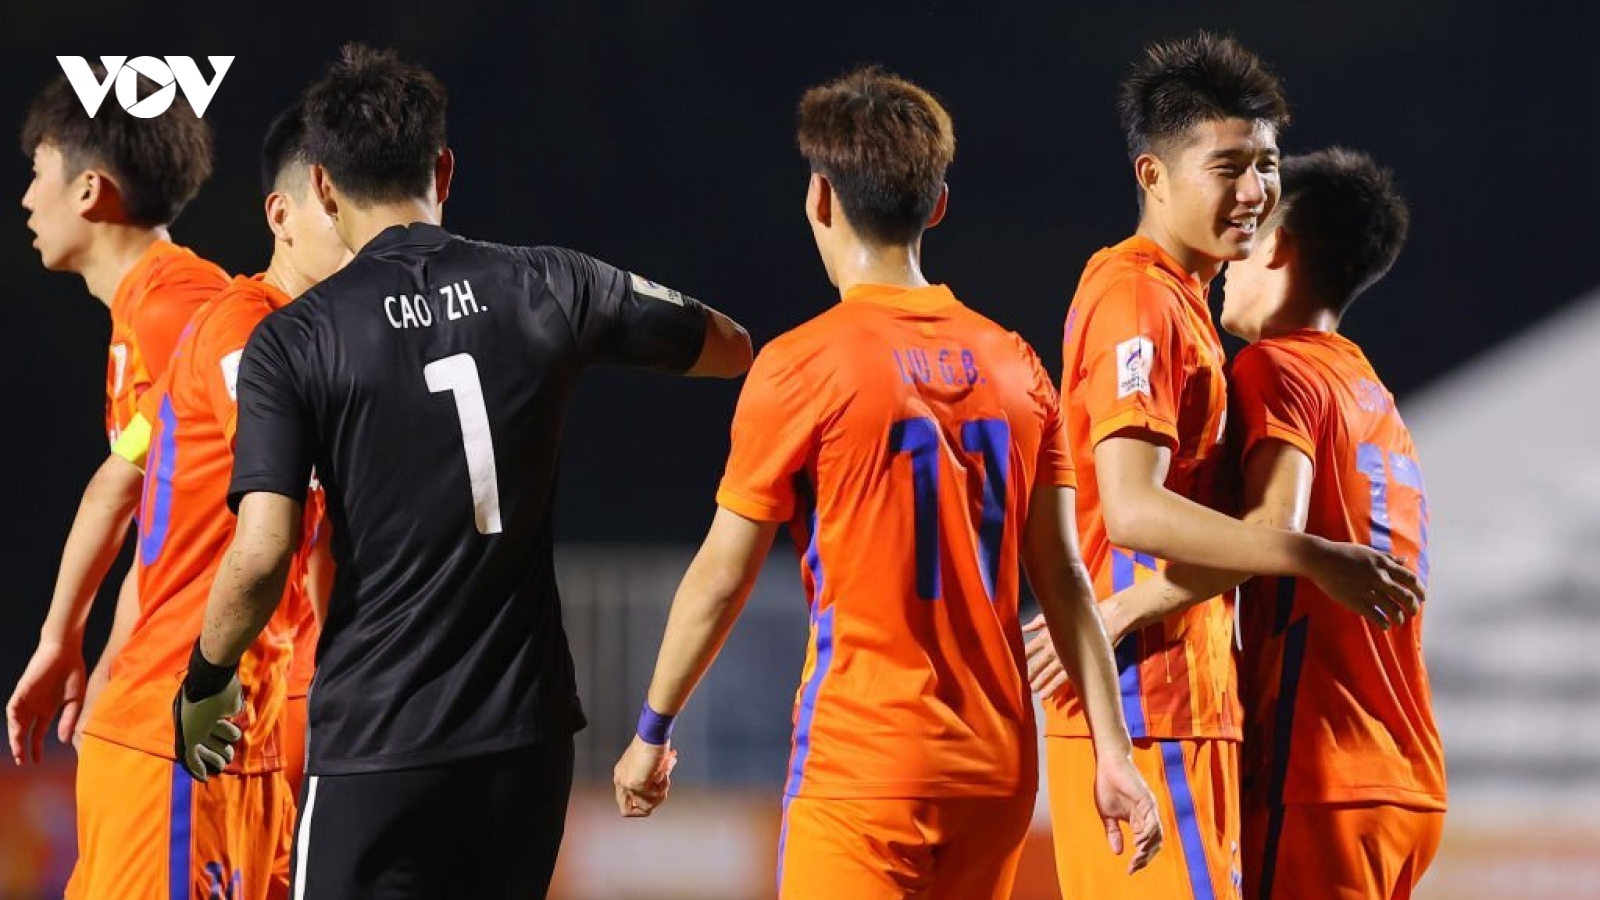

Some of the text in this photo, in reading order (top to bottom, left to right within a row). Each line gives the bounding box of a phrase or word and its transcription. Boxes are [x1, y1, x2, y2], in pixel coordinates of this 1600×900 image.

[384, 279, 488, 329] CAO ZH.
[893, 349, 987, 386] LIU G.B.
[424, 353, 503, 534] 1
